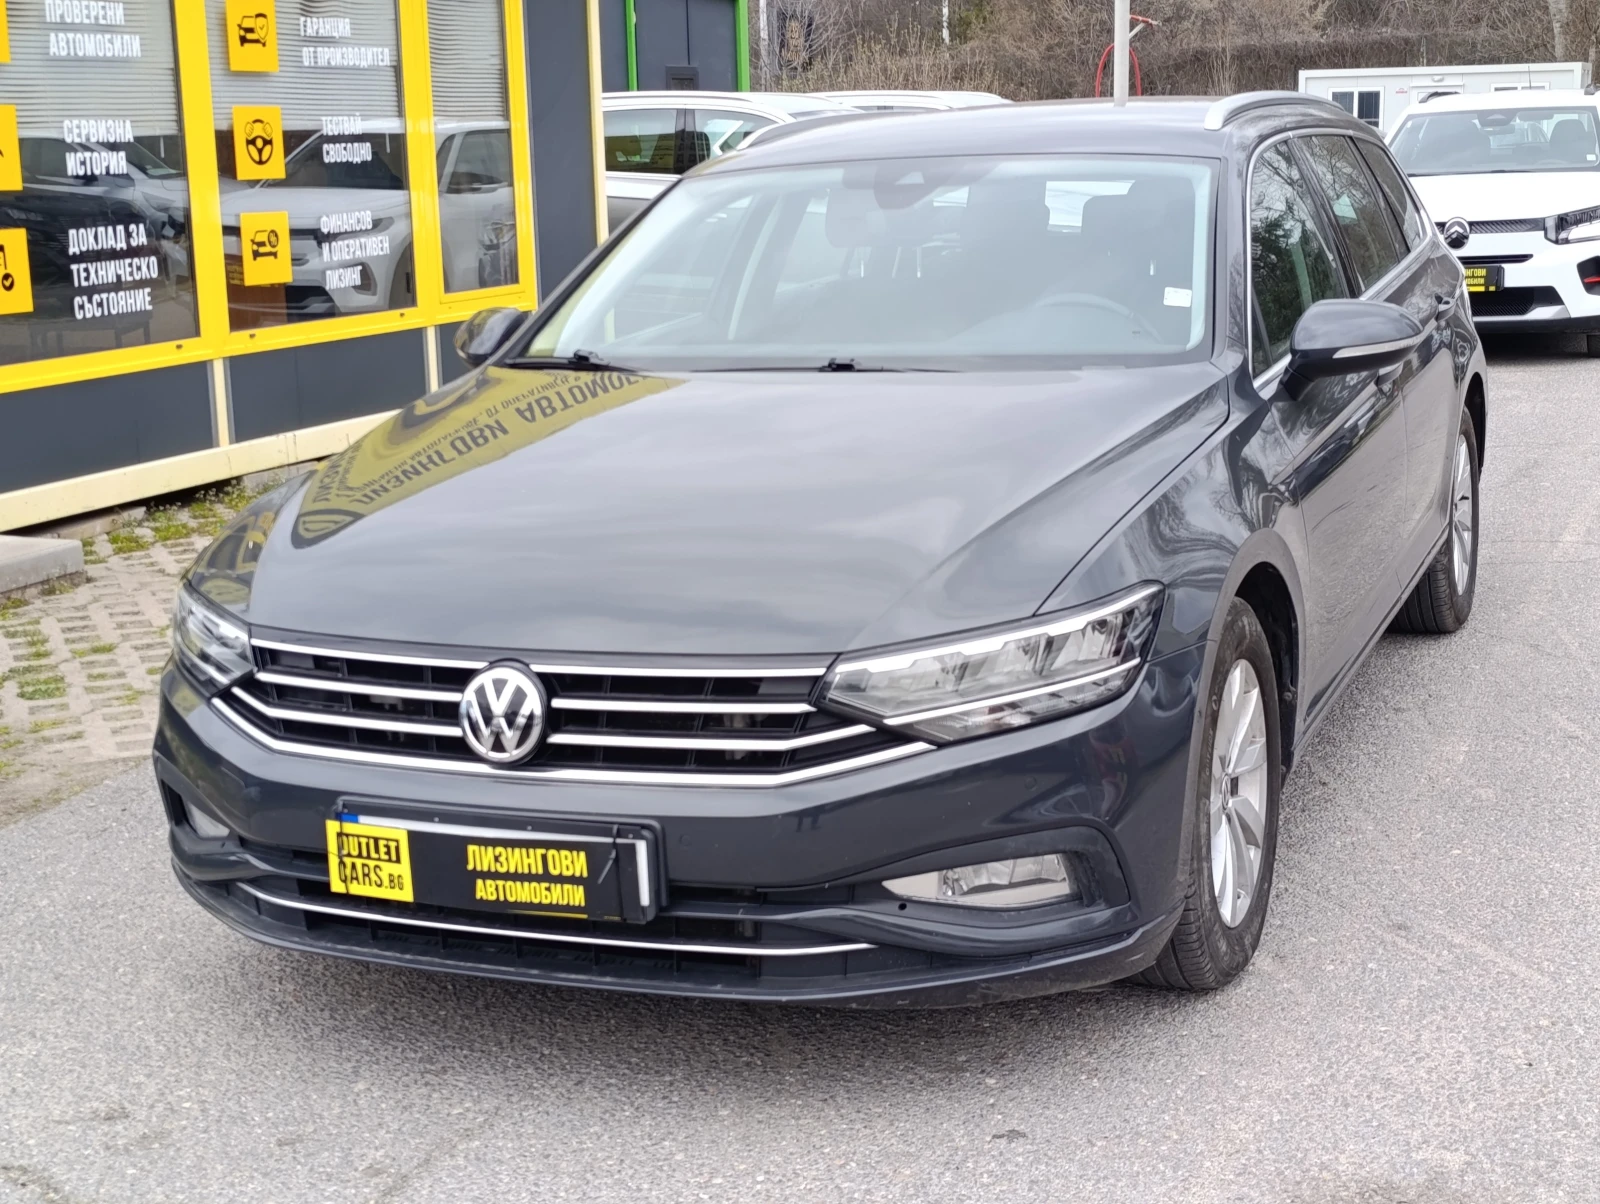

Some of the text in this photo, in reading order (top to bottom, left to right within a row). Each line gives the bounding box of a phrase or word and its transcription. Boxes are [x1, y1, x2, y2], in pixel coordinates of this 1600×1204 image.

[45, 0, 125, 25] ПРОВЕРЕНИ
[300, 17, 351, 38] ГАРАНЦИЯ
[49, 32, 141, 58] АВТОМОБИЛИ
[302, 47, 390, 68] ОТ ПРОИЗВОДИТЕЛ
[63, 119, 134, 143] СЕРВИЗНА
[321, 112, 363, 136] ТЕСТВАЙ
[65, 151, 128, 177] ИСТОРИЯ
[322, 142, 372, 164] СВОБОДНО
[320, 210, 373, 235] ФИНАНСОВ
[68, 223, 147, 256] ДОКЛАД ЗА
[322, 236, 390, 262] И ОПЕРАТИВЕН
[70, 255, 159, 288] ТЕХНИЧЕСКО
[325, 265, 363, 290] ЛИЗИНГ
[1465, 268, 1487, 277] НГОВИ
[73, 287, 153, 321] СЪСТОЯНИЕ
[466, 844, 588, 879] ЛИЗИНГОВИ
[338, 860, 404, 891] CARS.BG
[475, 878, 585, 908] АВТОМОБИЛИ
